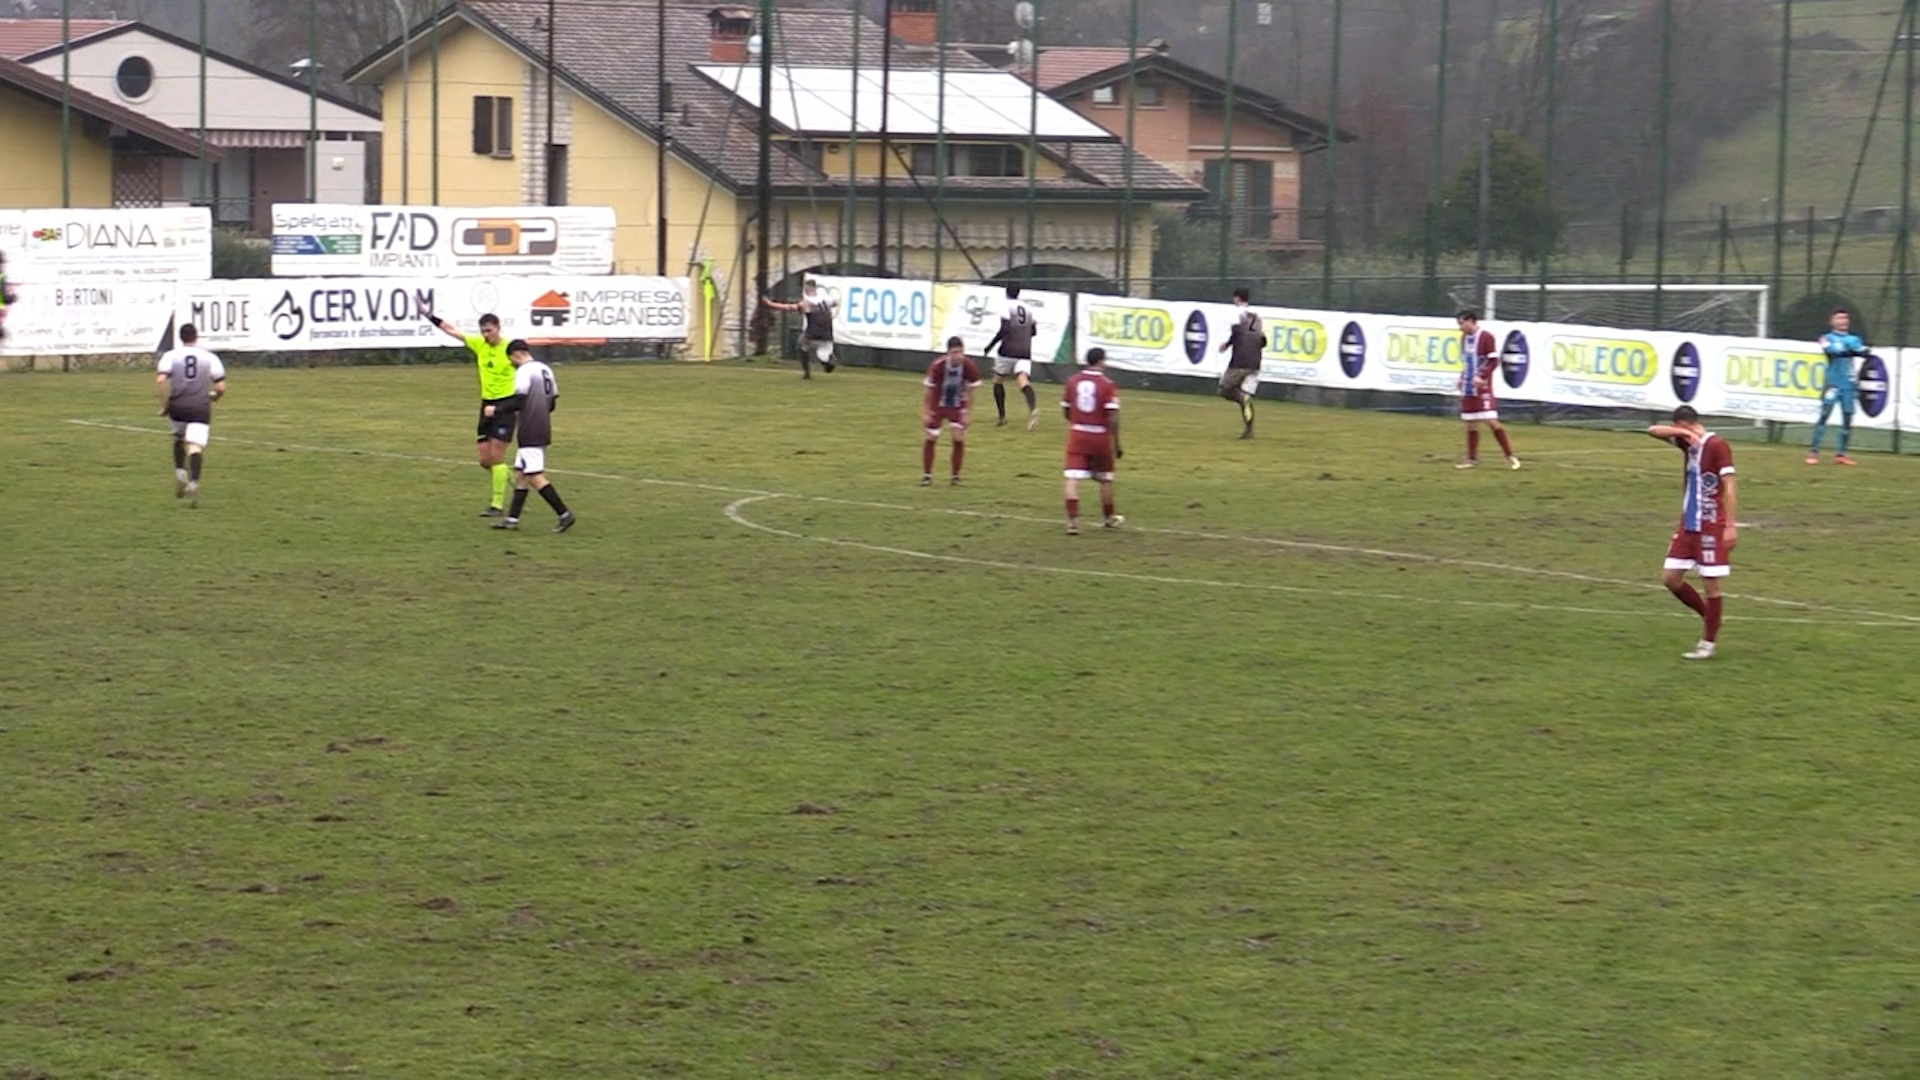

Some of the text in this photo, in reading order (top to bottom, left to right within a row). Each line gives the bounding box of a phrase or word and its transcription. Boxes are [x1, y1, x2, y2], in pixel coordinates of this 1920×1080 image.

[66, 220, 158, 249] DIANA
[370, 212, 439, 250] FAD
[369, 253, 439, 268] IMPIANTI
[576, 291, 684, 303] IMPRESA
[191, 301, 250, 332] MORE
[1017, 305, 1026, 324] 9
[184, 355, 197, 379] 8
[541, 369, 553, 395] 6
[1076, 380, 1097, 413] 8
